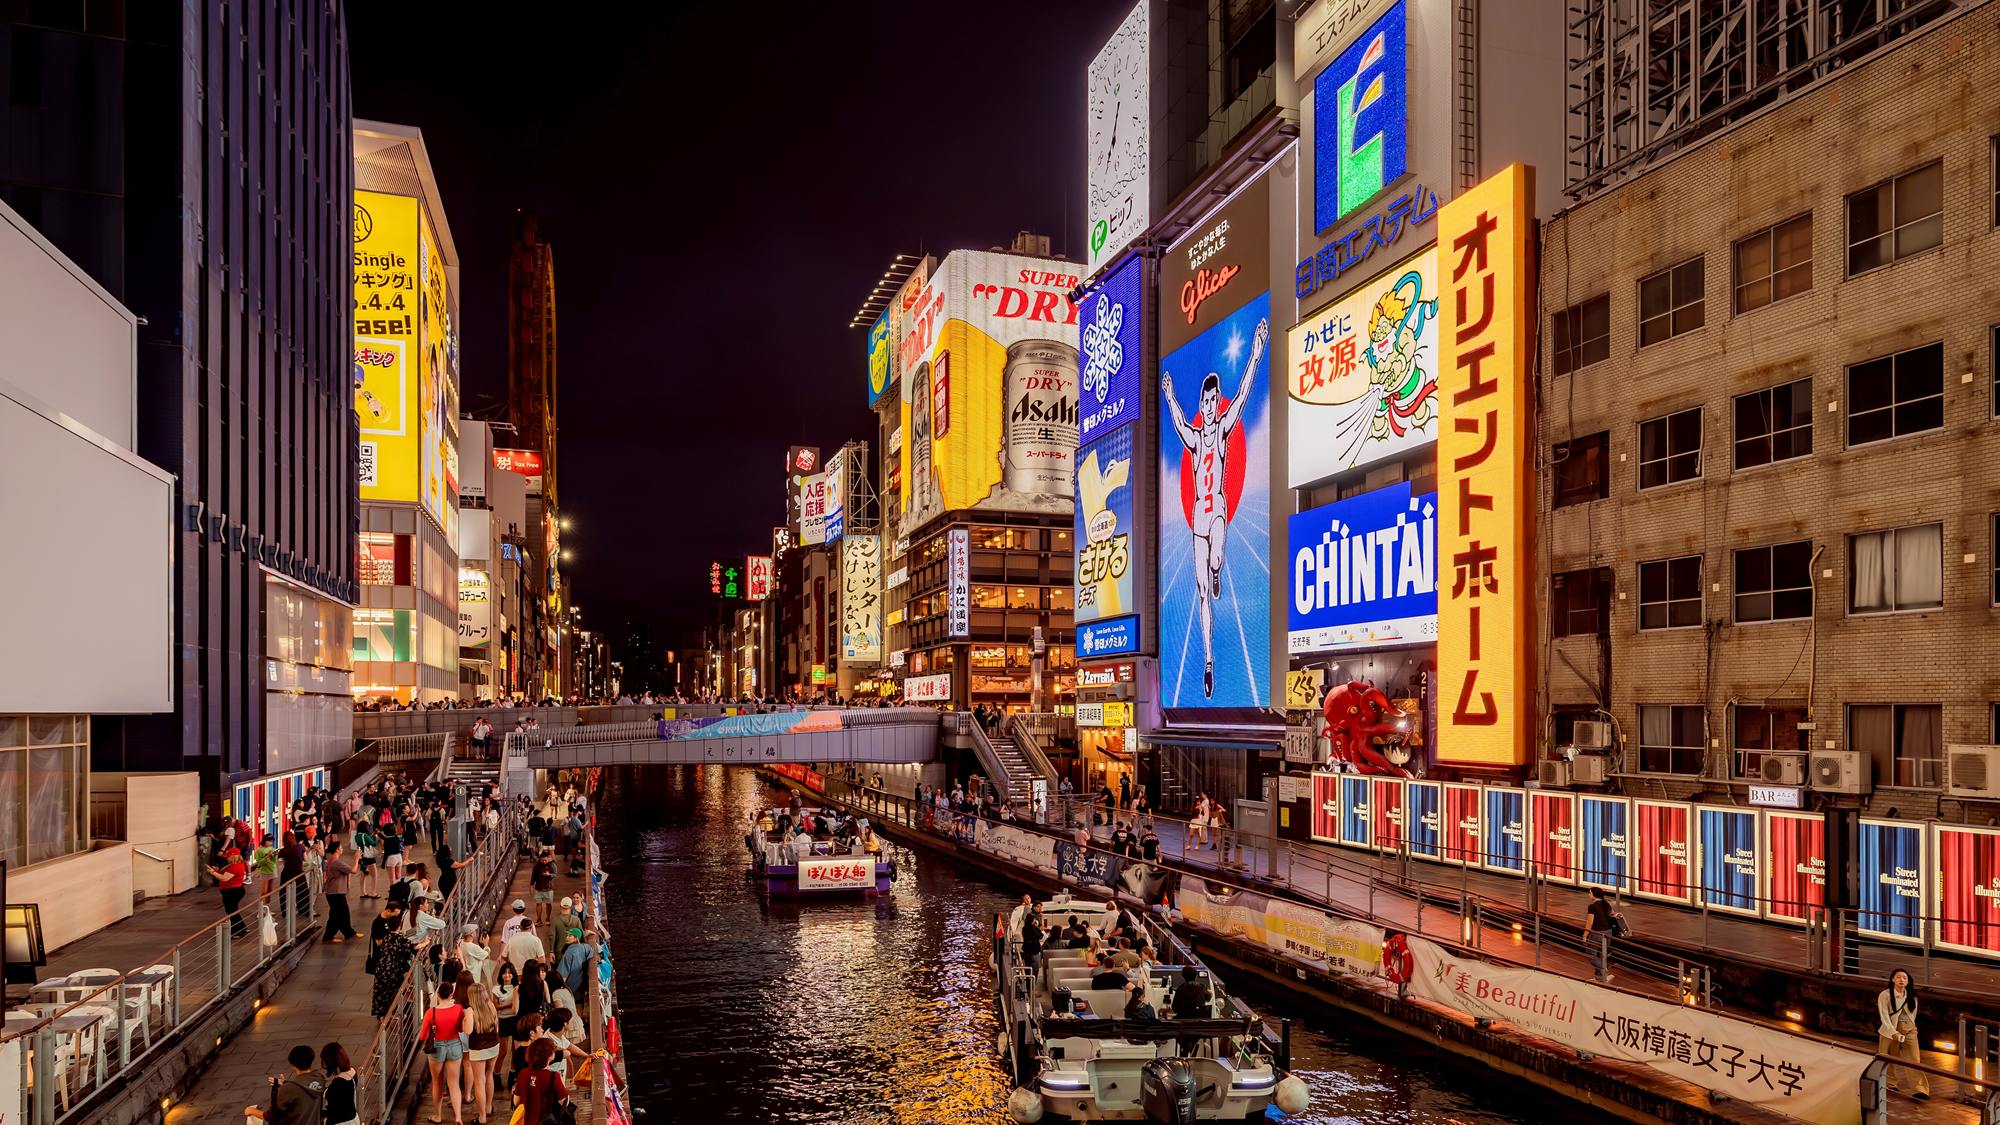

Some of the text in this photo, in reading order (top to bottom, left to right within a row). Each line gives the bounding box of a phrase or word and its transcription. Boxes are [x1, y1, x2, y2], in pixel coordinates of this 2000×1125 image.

[1109, 193, 1134, 234] ピップ
[1296, 183, 1438, 299] 日商エステム
[354, 253, 405, 270] Single
[1190, 236, 1226, 271] ゆたかな人生
[1018, 269, 1079, 290] SUPER
[1304, 314, 1352, 353] かぜに
[1034, 369, 1060, 377] SUPER
[1299, 333, 1357, 396] 改源
[1011, 391, 1079, 427] Asahi
[1083, 398, 1125, 433] 雪印メグミルク
[1038, 427, 1055, 441] 生
[526, 461, 539, 469] Free
[1026, 450, 1068, 461] スーパードライ
[1452, 210, 1499, 728] オリエントホーム
[805, 481, 825, 499] 入店
[1203, 447, 1214, 515] グリコ
[805, 499, 825, 518] 応援
[1079, 533, 1128, 586] さける
[1295, 497, 1435, 615] CHINTAI
[844, 541, 861, 635] だけじゃない
[860, 537, 880, 628] シャッター
[1078, 585, 1097, 609] チーズ
[955, 584, 966, 633] かに道楽
[459, 624, 488, 640] グループ
[1094, 635, 1128, 651] 雪印メグミルク
[1085, 671, 1115, 685] ZETTERIA
[1293, 675, 1316, 704] くくる
[1751, 790, 1775, 802] BAR
[1558, 826, 1570, 835] Street
[1611, 832, 1624, 841] Street
[1670, 840, 1684, 850] Street
[1736, 848, 1752, 858] Street
[807, 865, 866, 881] ぽんぽん船
[1895, 866, 1917, 878] Street
[1455, 971, 1577, 1023] 美 Beautiful
[1592, 1011, 1806, 1097] 大阪樟蔭女子大学
